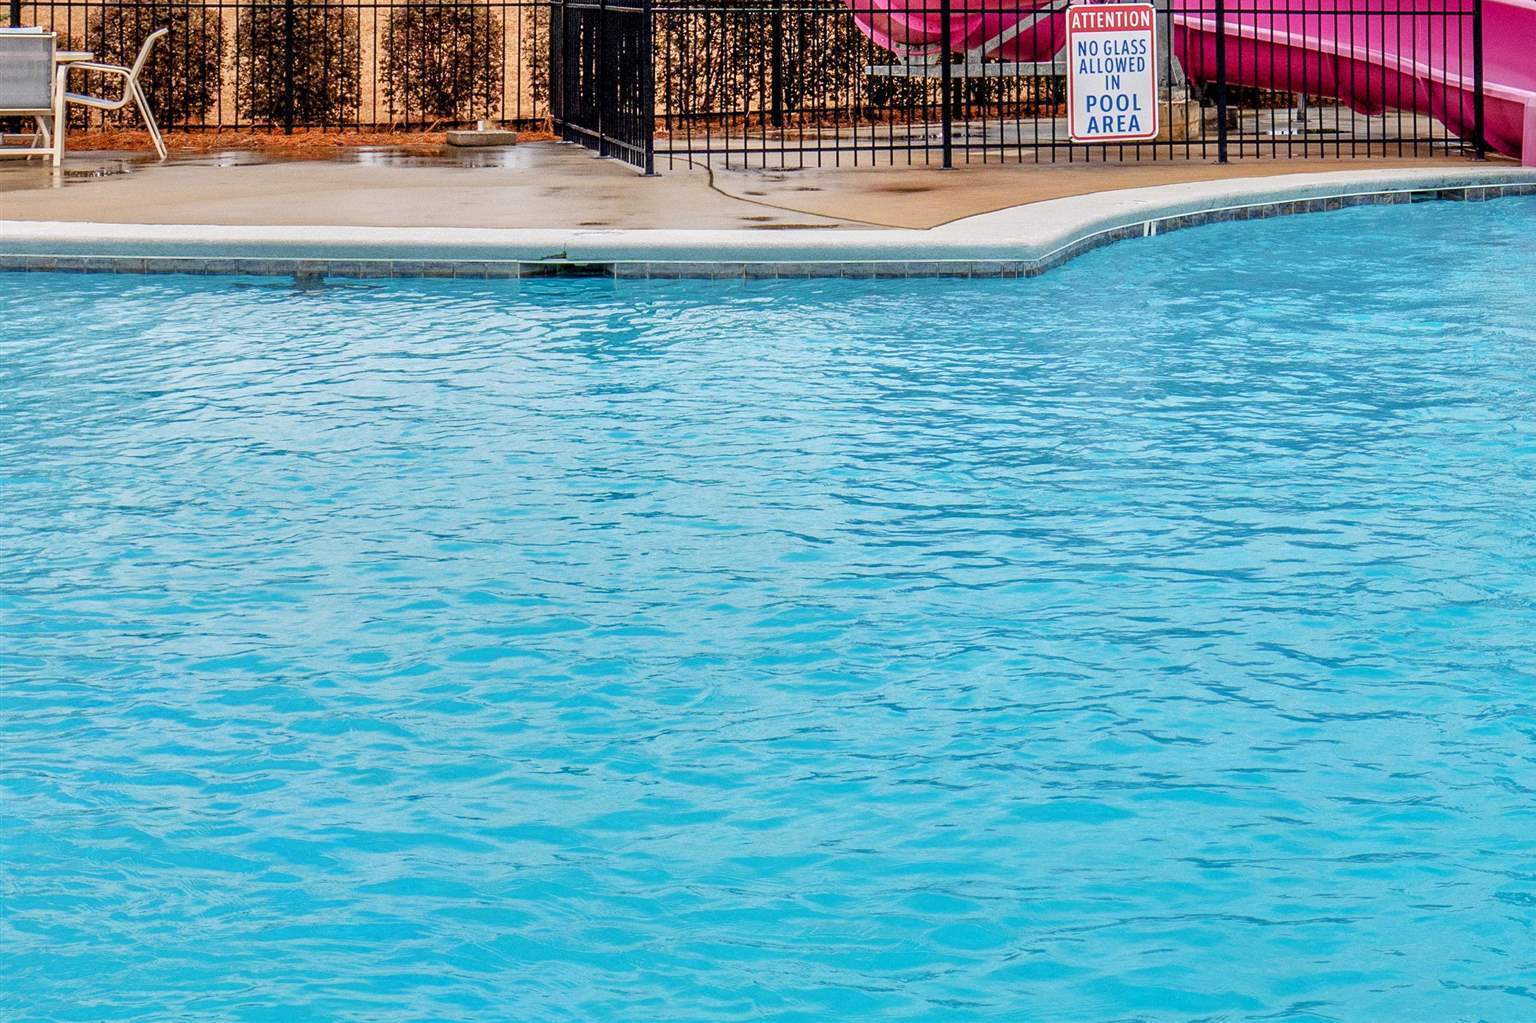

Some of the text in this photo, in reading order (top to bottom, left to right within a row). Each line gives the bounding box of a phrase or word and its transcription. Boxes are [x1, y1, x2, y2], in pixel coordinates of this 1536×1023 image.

[1072, 11, 1151, 29] ATTENTION
[1078, 39, 1146, 57] NO GLASS
[1079, 56, 1145, 74] ALLOWED
[1105, 75, 1121, 91] IN
[1087, 94, 1141, 113] POOL
[1087, 114, 1141, 134] AREA
